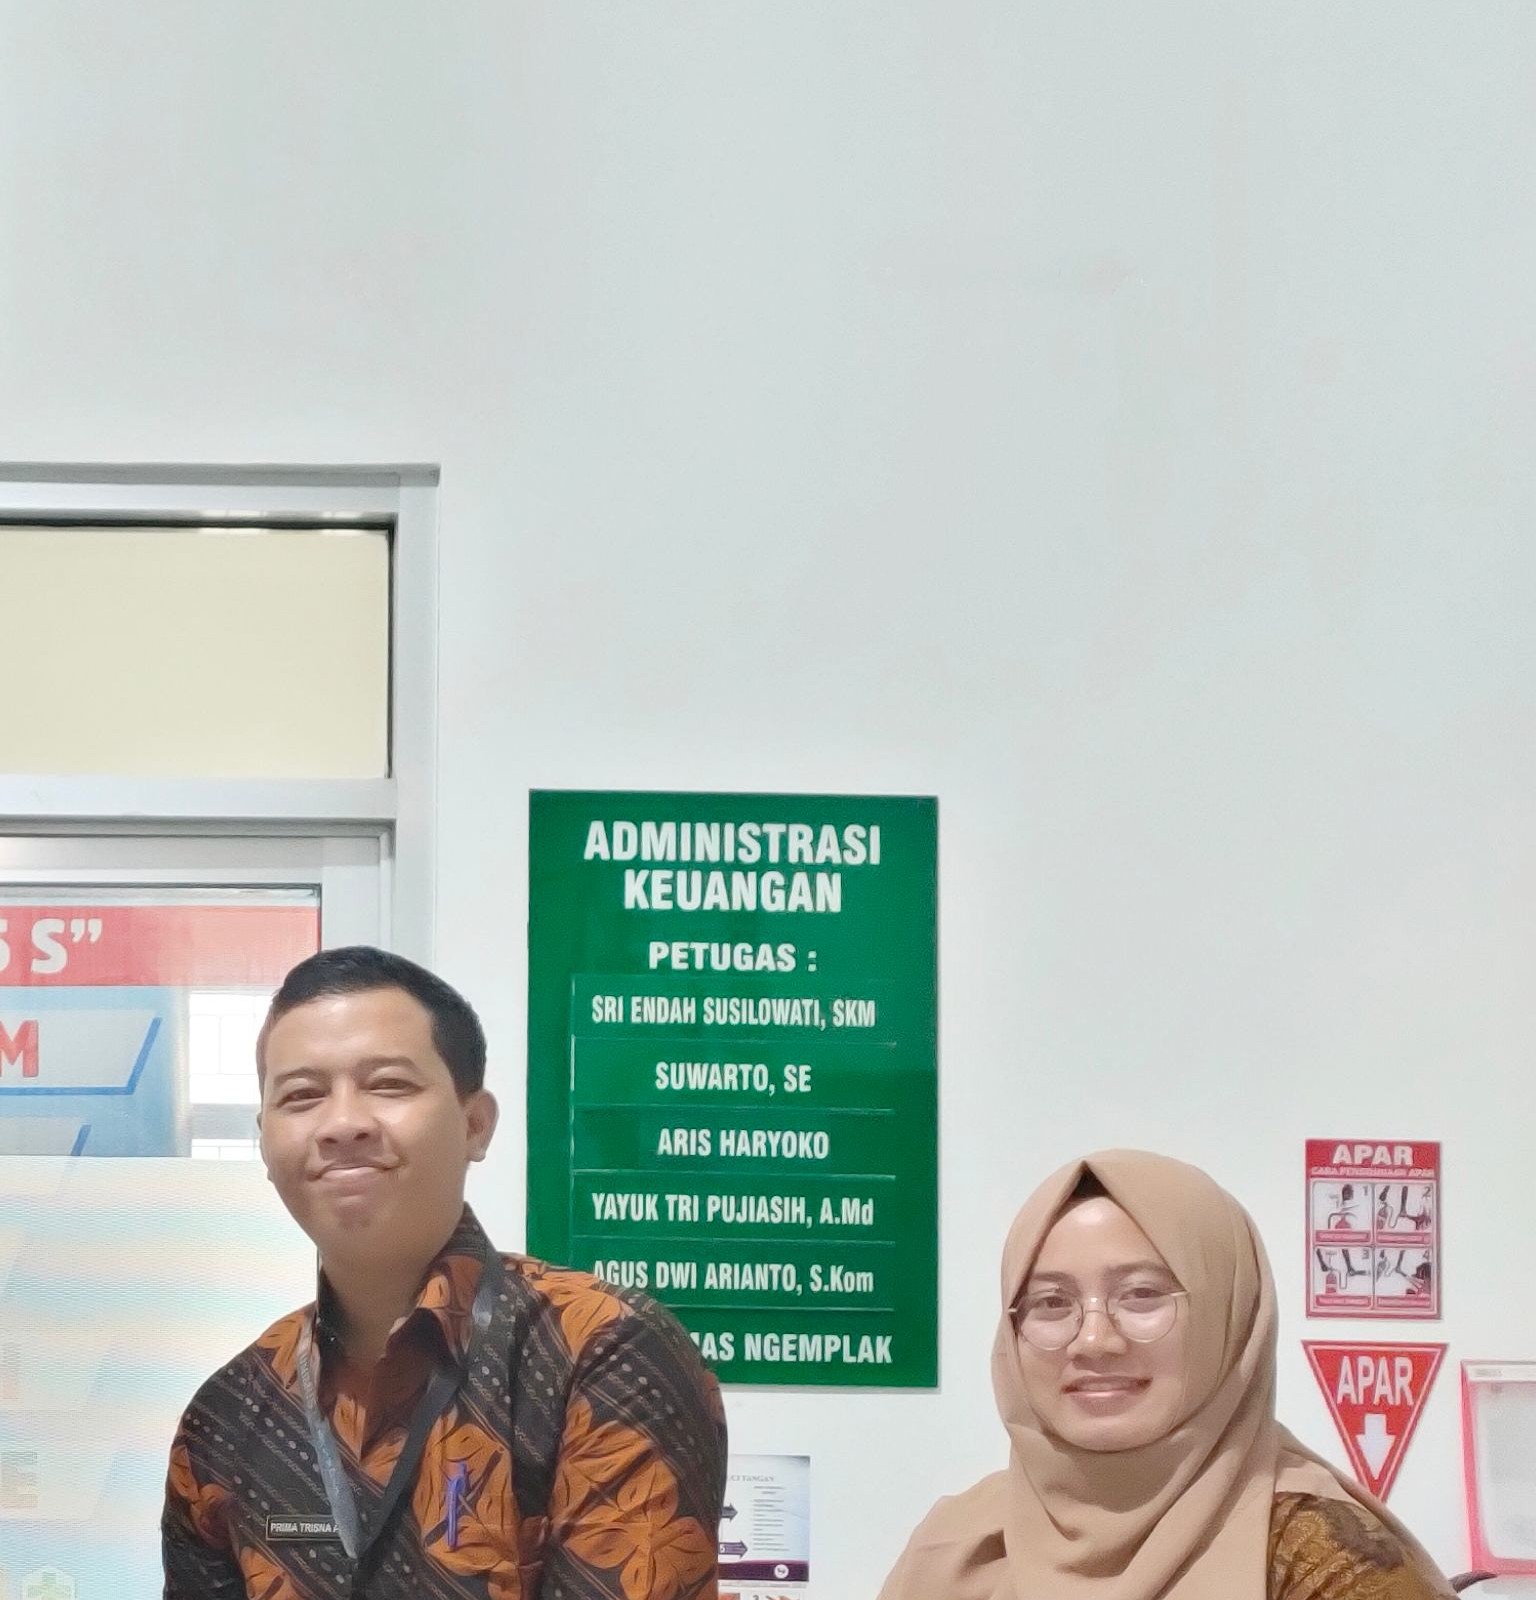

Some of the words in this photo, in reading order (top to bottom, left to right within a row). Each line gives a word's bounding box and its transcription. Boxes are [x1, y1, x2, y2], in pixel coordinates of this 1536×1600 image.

[583, 819, 881, 866] ADMINISTRASI
[624, 868, 842, 913] KEUANGAN
[648, 941, 796, 972] PETUGAS
[591, 994, 623, 1023] SRI
[631, 995, 696, 1025] ENDAH
[703, 996, 825, 1031] SUSILOWATI,
[832, 998, 876, 1028] SKM
[655, 1061, 775, 1097] SUWARTO,
[783, 1064, 812, 1092] SE
[657, 1128, 712, 1157] ARIS
[720, 1129, 830, 1159] HARYOKO
[1332, 1144, 1414, 1167] APAR
[1423, 1186, 1431, 1198] 2
[592, 1192, 659, 1221] YAYUK
[665, 1193, 699, 1222] TRI
[707, 1194, 813, 1229] PUJIASIH,
[819, 1197, 874, 1226] A.Md
[593, 1260, 648, 1289] AGUS
[655, 1261, 697, 1290] DWI
[703, 1262, 803, 1296] ARIANTO,
[809, 1264, 874, 1293] S.Kom
[743, 1332, 894, 1364] NGEMPLAK
[1337, 1355, 1414, 1406] APAR
[270, 1522, 298, 1533] PRIMA
[300, 1522, 332, 1533] TRISNA
